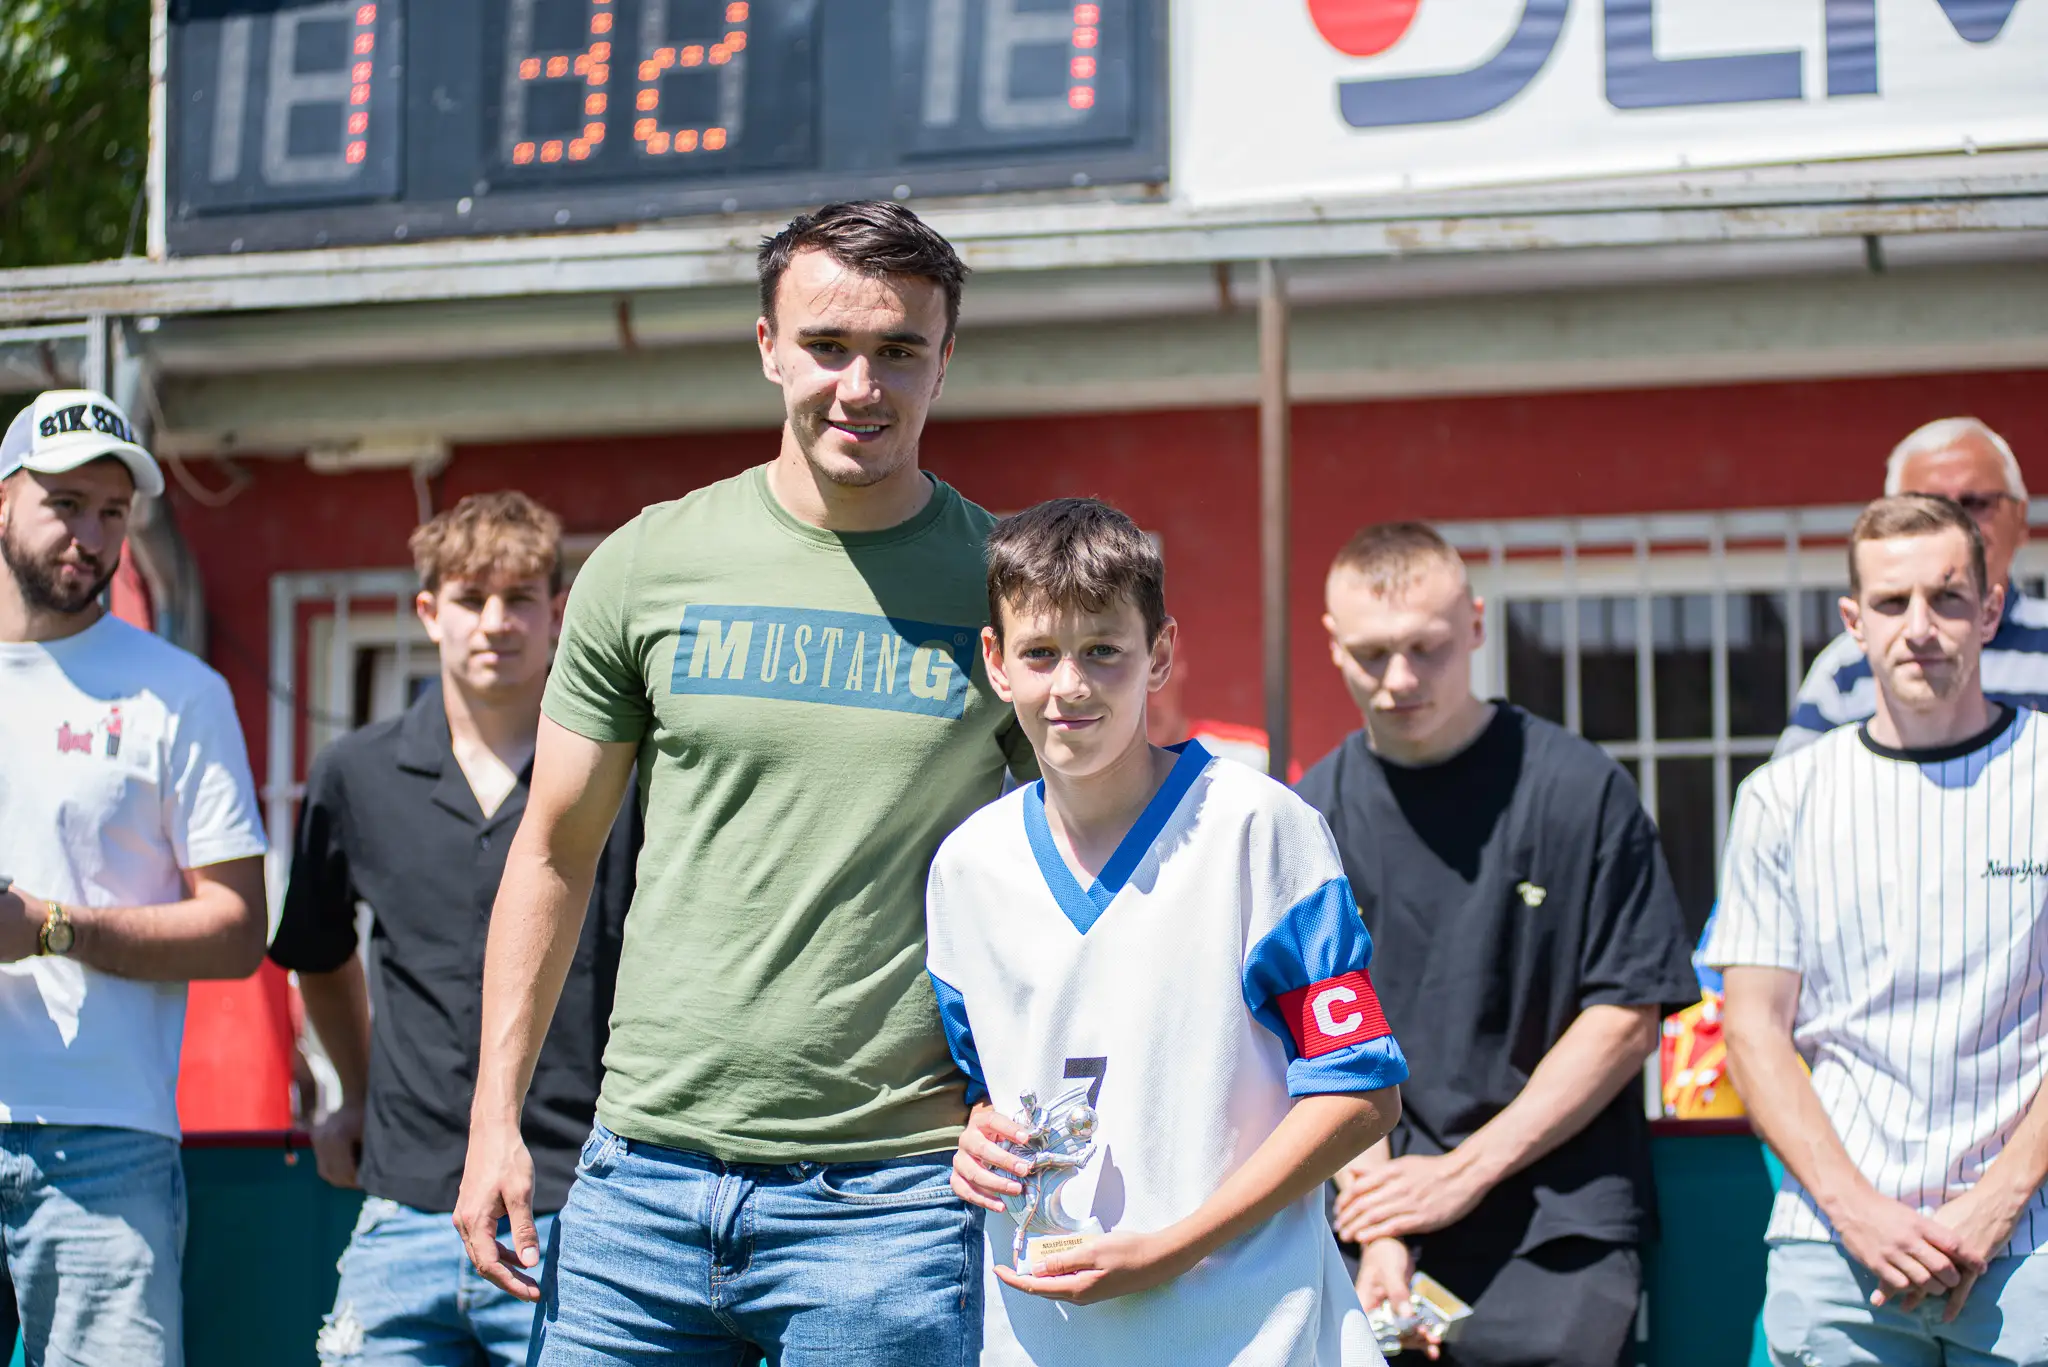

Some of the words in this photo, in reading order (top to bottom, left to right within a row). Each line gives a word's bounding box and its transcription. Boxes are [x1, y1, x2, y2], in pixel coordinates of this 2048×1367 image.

[688, 619, 956, 701] MUSTANG
[1311, 986, 1364, 1037] C
[1063, 1056, 1107, 1143] 7
